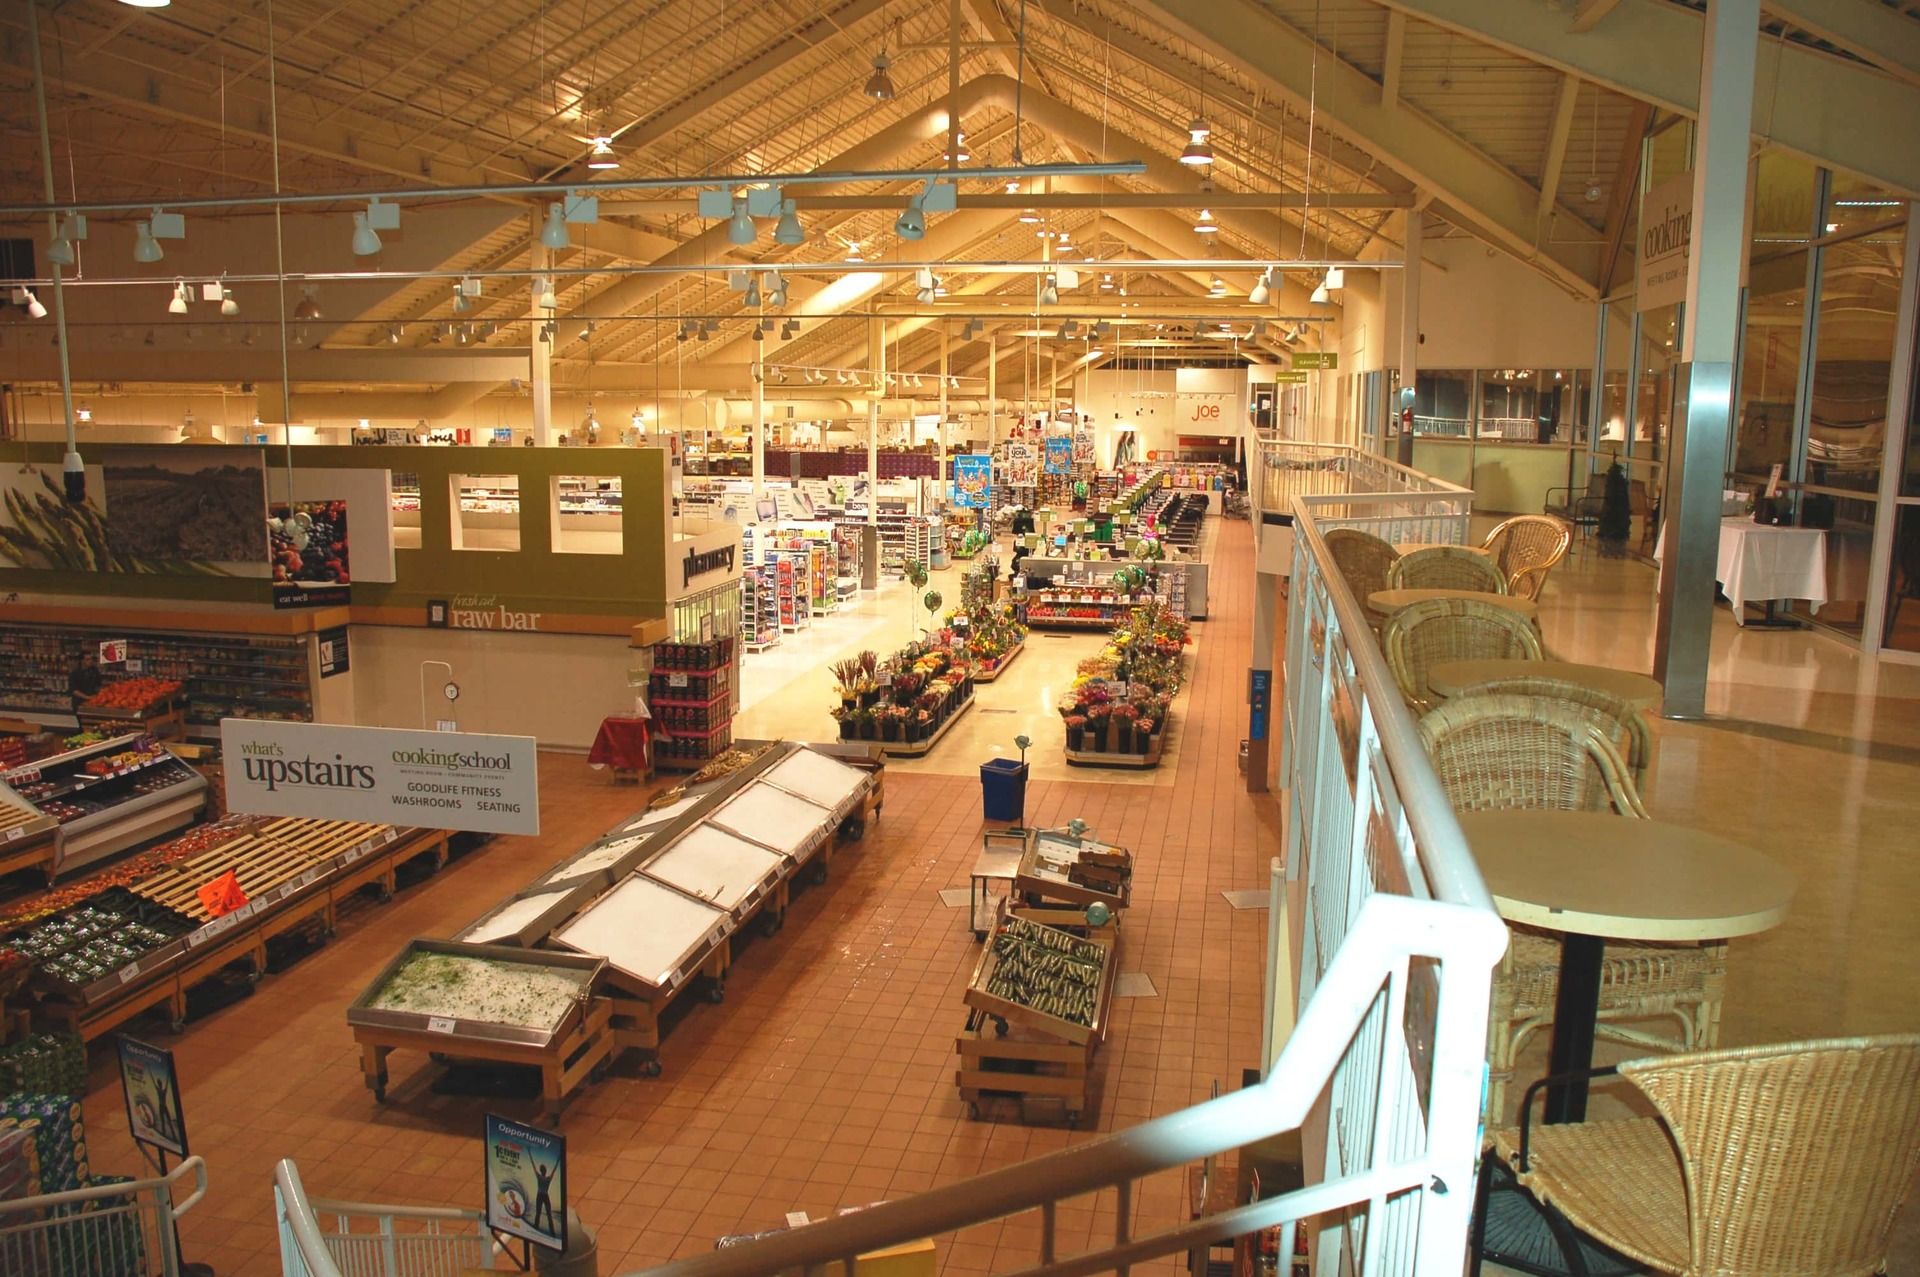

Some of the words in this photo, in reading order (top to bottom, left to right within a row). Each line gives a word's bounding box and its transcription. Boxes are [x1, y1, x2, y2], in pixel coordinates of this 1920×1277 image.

[683, 544, 736, 588] pharmacy
[451, 609, 495, 628] raw
[499, 605, 541, 631] bar
[241, 741, 284, 757] what's
[392, 747, 511, 771] cookingschool
[242, 753, 376, 791] upstairs
[407, 782, 459, 795] GOODLIFE
[461, 785, 502, 798] FITNESS
[391, 795, 462, 809] WASHROOMS
[477, 801, 521, 814] SEATING
[498, 1123, 551, 1148] Opportunity
